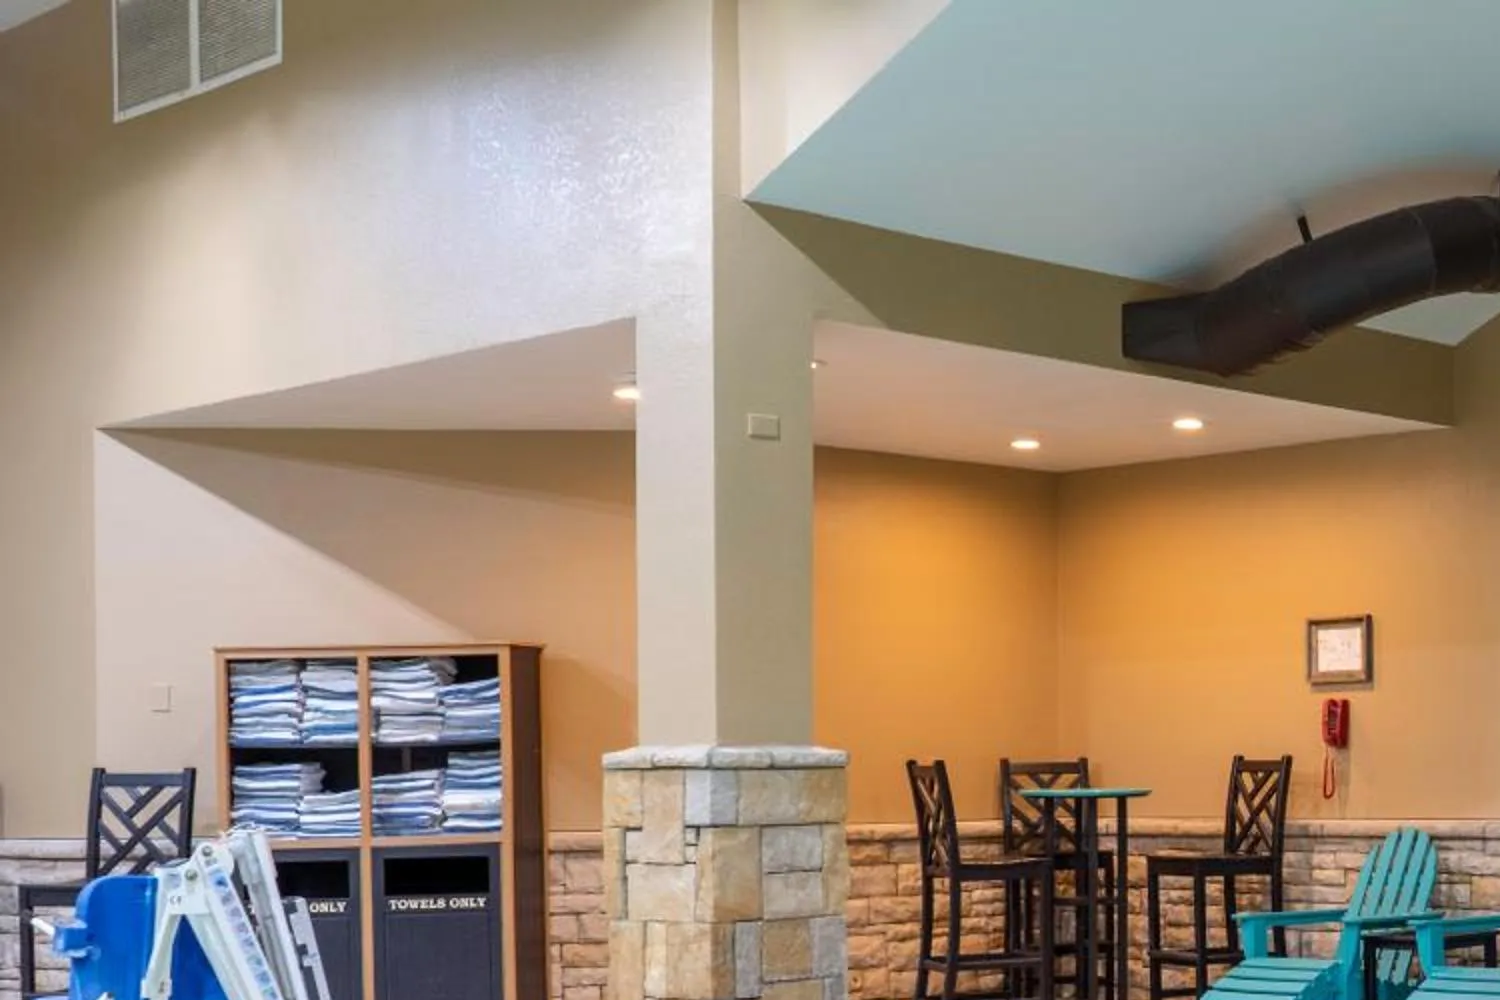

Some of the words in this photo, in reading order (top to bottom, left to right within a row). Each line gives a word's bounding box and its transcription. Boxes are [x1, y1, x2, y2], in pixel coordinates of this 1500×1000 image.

[308, 900, 348, 914] ONLY
[388, 898, 447, 912] TOWELS
[449, 896, 488, 910] ONLY
